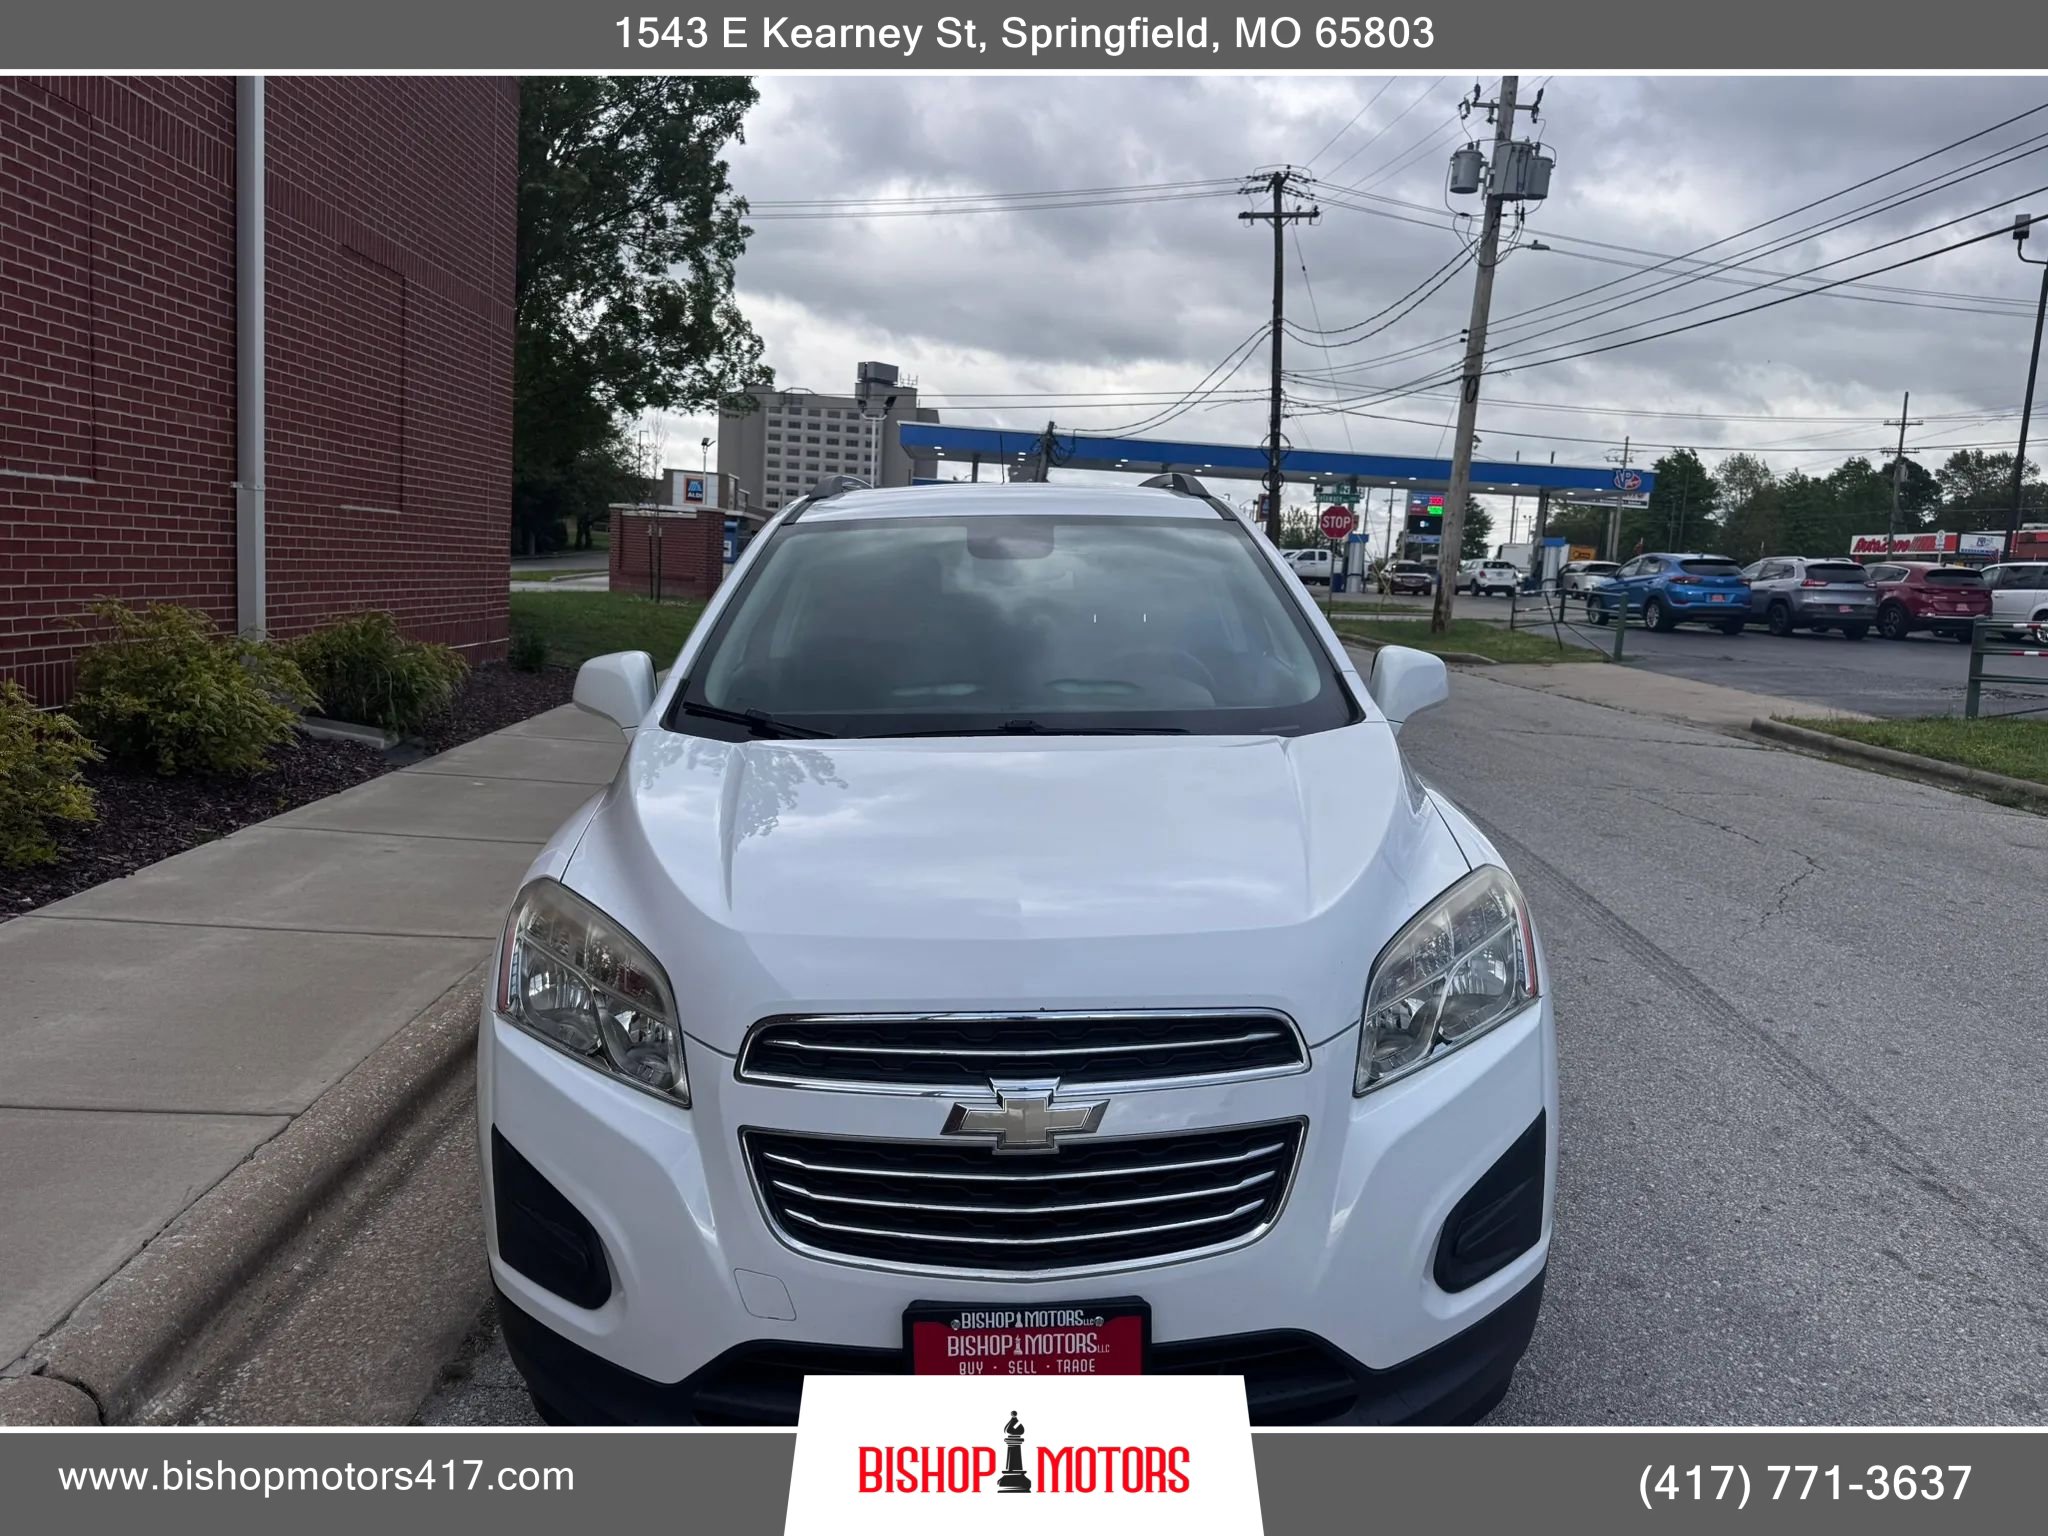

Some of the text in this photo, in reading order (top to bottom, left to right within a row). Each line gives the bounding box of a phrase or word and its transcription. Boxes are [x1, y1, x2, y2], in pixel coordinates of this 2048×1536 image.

[1321, 515, 1351, 528] STOP
[961, 1311, 1015, 1329] BISHOP
[1024, 1309, 1084, 1328] MOTORS
[947, 1332, 1110, 1357] BISHOP MOTORS LLC
[959, 1358, 1096, 1375] BUY SELL TRADE
